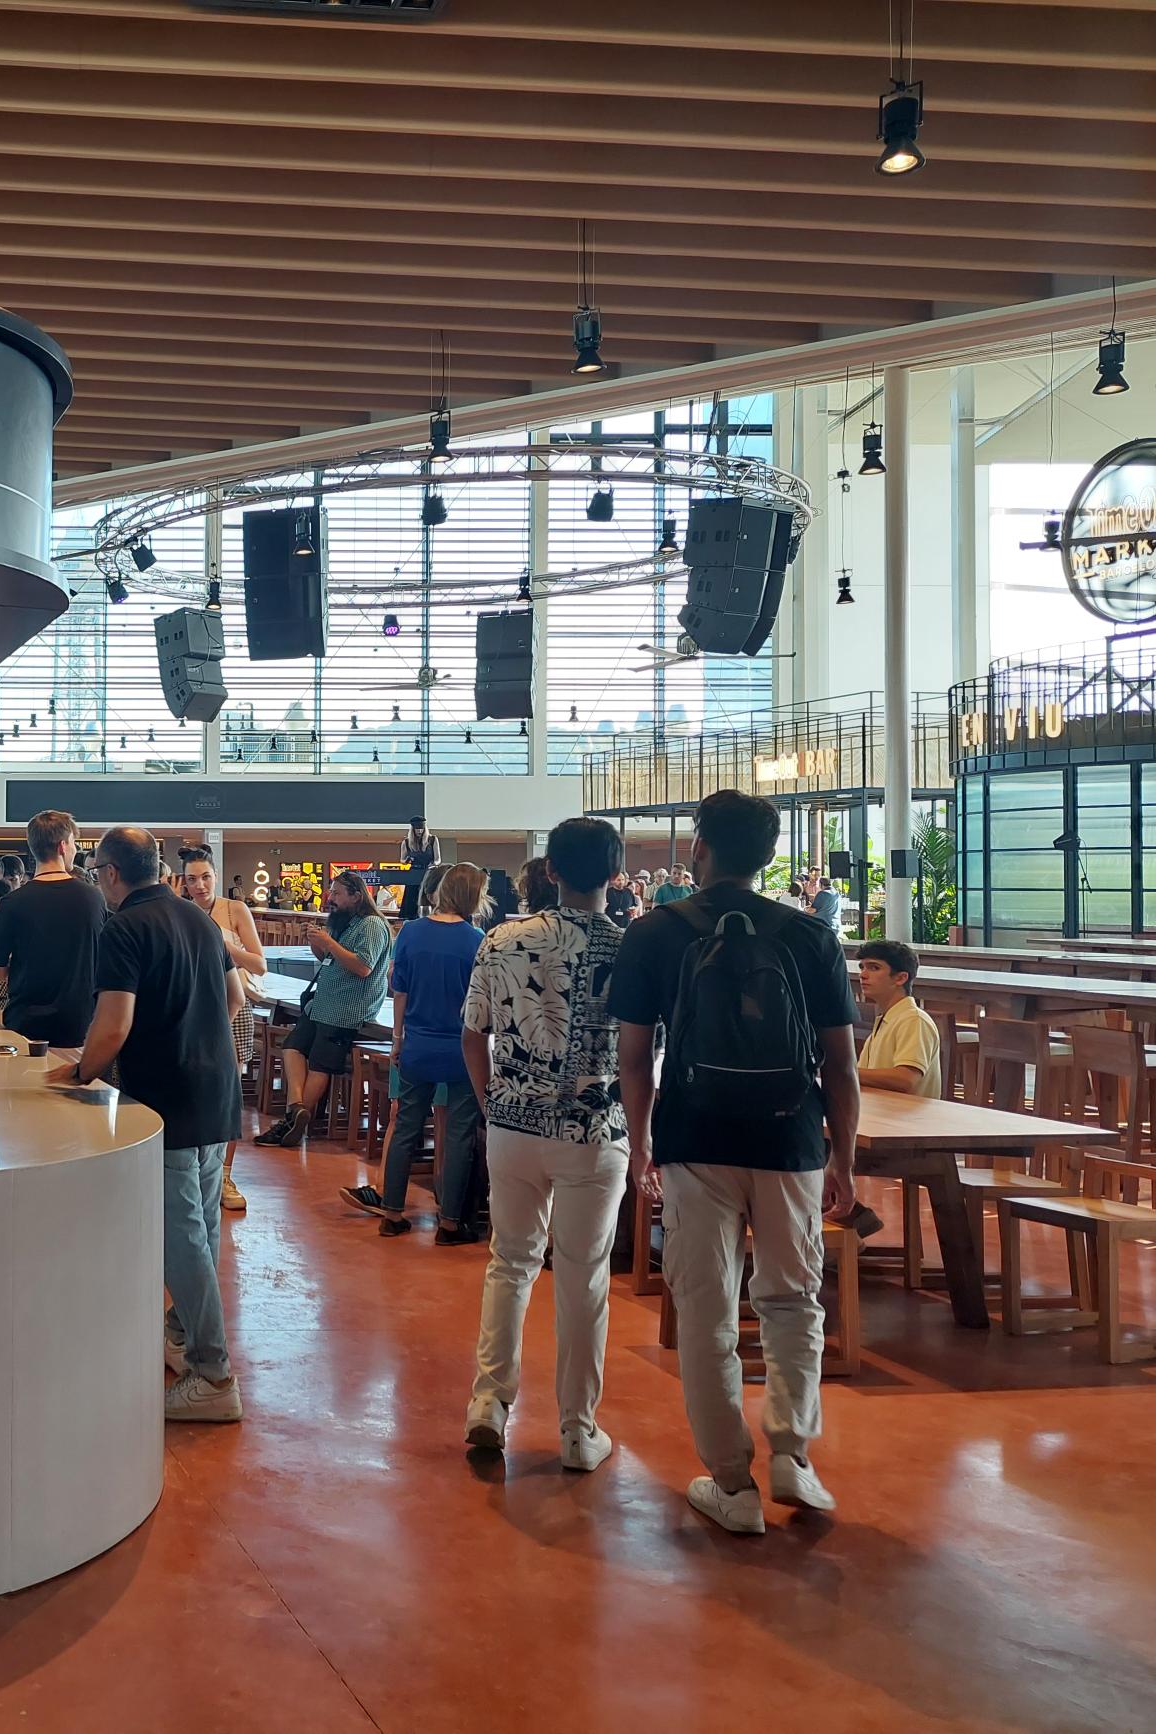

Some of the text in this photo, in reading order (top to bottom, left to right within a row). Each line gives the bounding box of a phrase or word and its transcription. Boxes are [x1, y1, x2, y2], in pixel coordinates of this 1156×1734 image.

[1071, 538, 1156, 570] MARK
[961, 713, 984, 747] EN
[805, 748, 836, 776] BAR
[77, 841, 93, 849] ARIA
